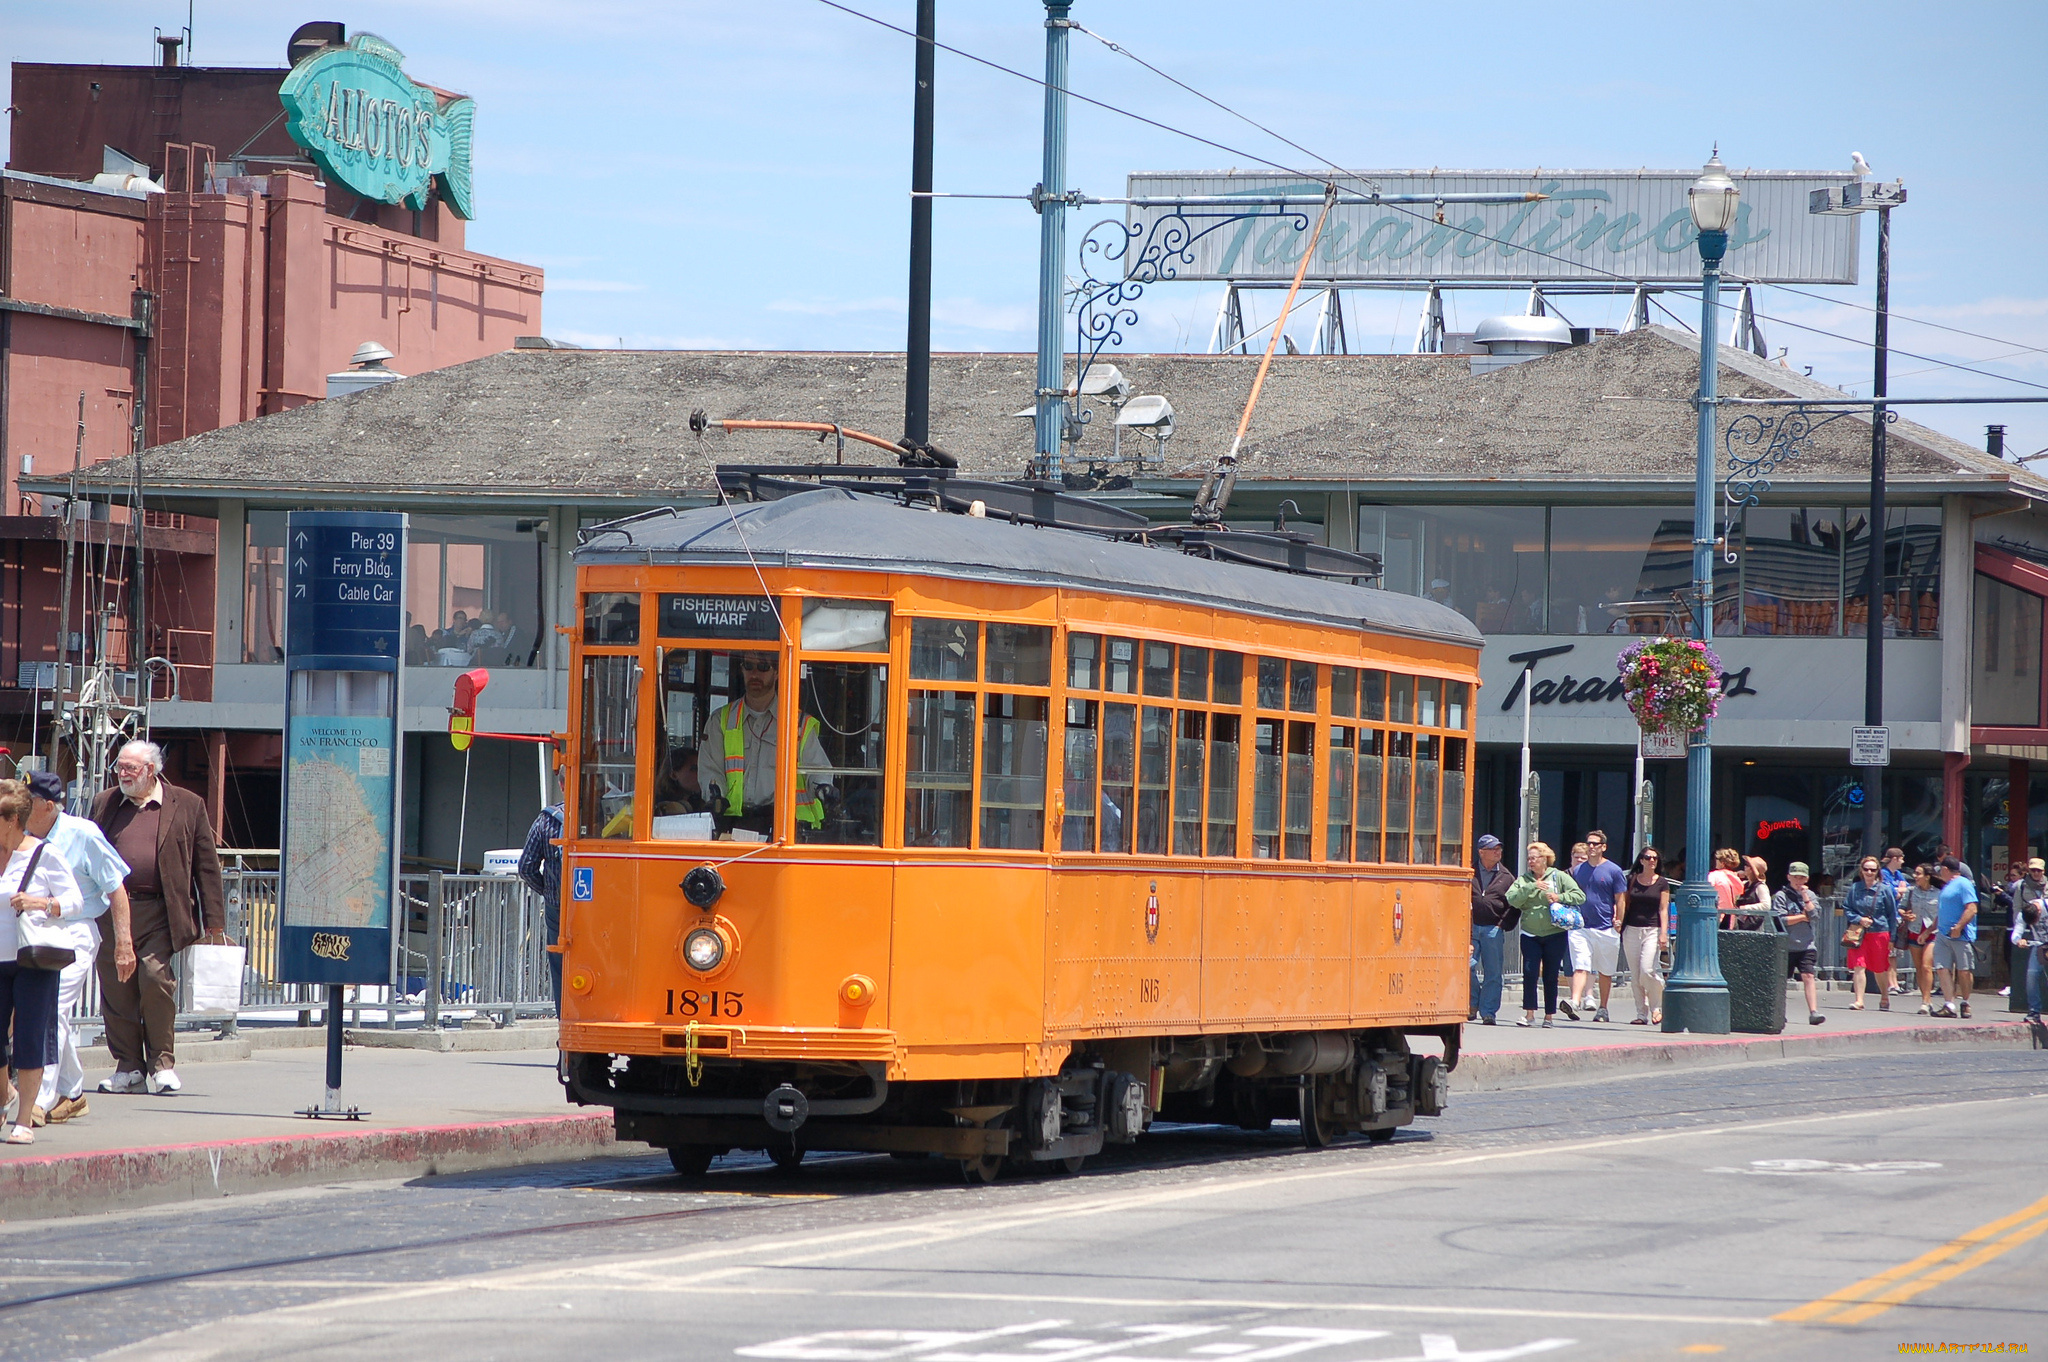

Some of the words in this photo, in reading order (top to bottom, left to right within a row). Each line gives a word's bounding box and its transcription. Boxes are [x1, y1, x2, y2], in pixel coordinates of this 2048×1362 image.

[323, 81, 434, 169] ALIOTO'S
[351, 531, 375, 550] Pier
[377, 532, 395, 551] 39
[333, 557, 362, 578] Ferry
[365, 557, 394, 579] Bldg.
[338, 582, 370, 601] Cable
[373, 583, 394, 602] Car
[672, 597, 771, 613] FISHERMAN'S
[695, 612, 748, 626] WHARF
[299, 736, 316, 746] SAN
[319, 737, 378, 747] FRANCISCO
[311, 728, 347, 736] WELCOME
[351, 728, 362, 736] TO
[1653, 736, 1676, 746] TIME
[1140, 978, 1160, 1003] 1815
[1388, 973, 1404, 995] 1815
[665, 989, 744, 1018] 1815
